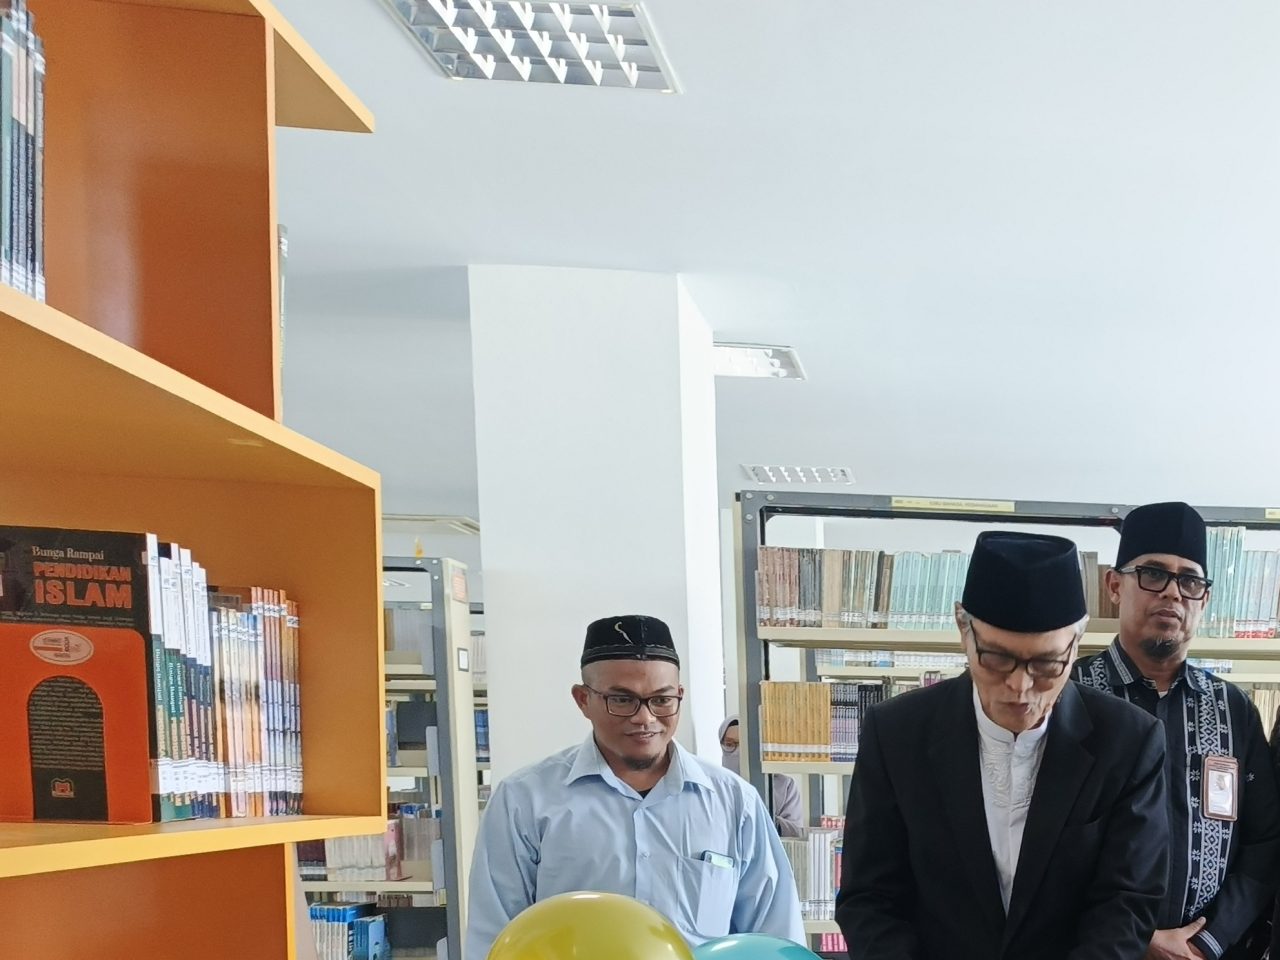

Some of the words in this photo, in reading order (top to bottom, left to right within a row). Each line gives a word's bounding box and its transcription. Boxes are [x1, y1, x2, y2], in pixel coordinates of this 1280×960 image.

[31, 545, 65, 560] Bunga
[67, 547, 105, 562] Rampai
[33, 562, 132, 581] PENDIDIKAN
[34, 579, 132, 609] ISLAM
